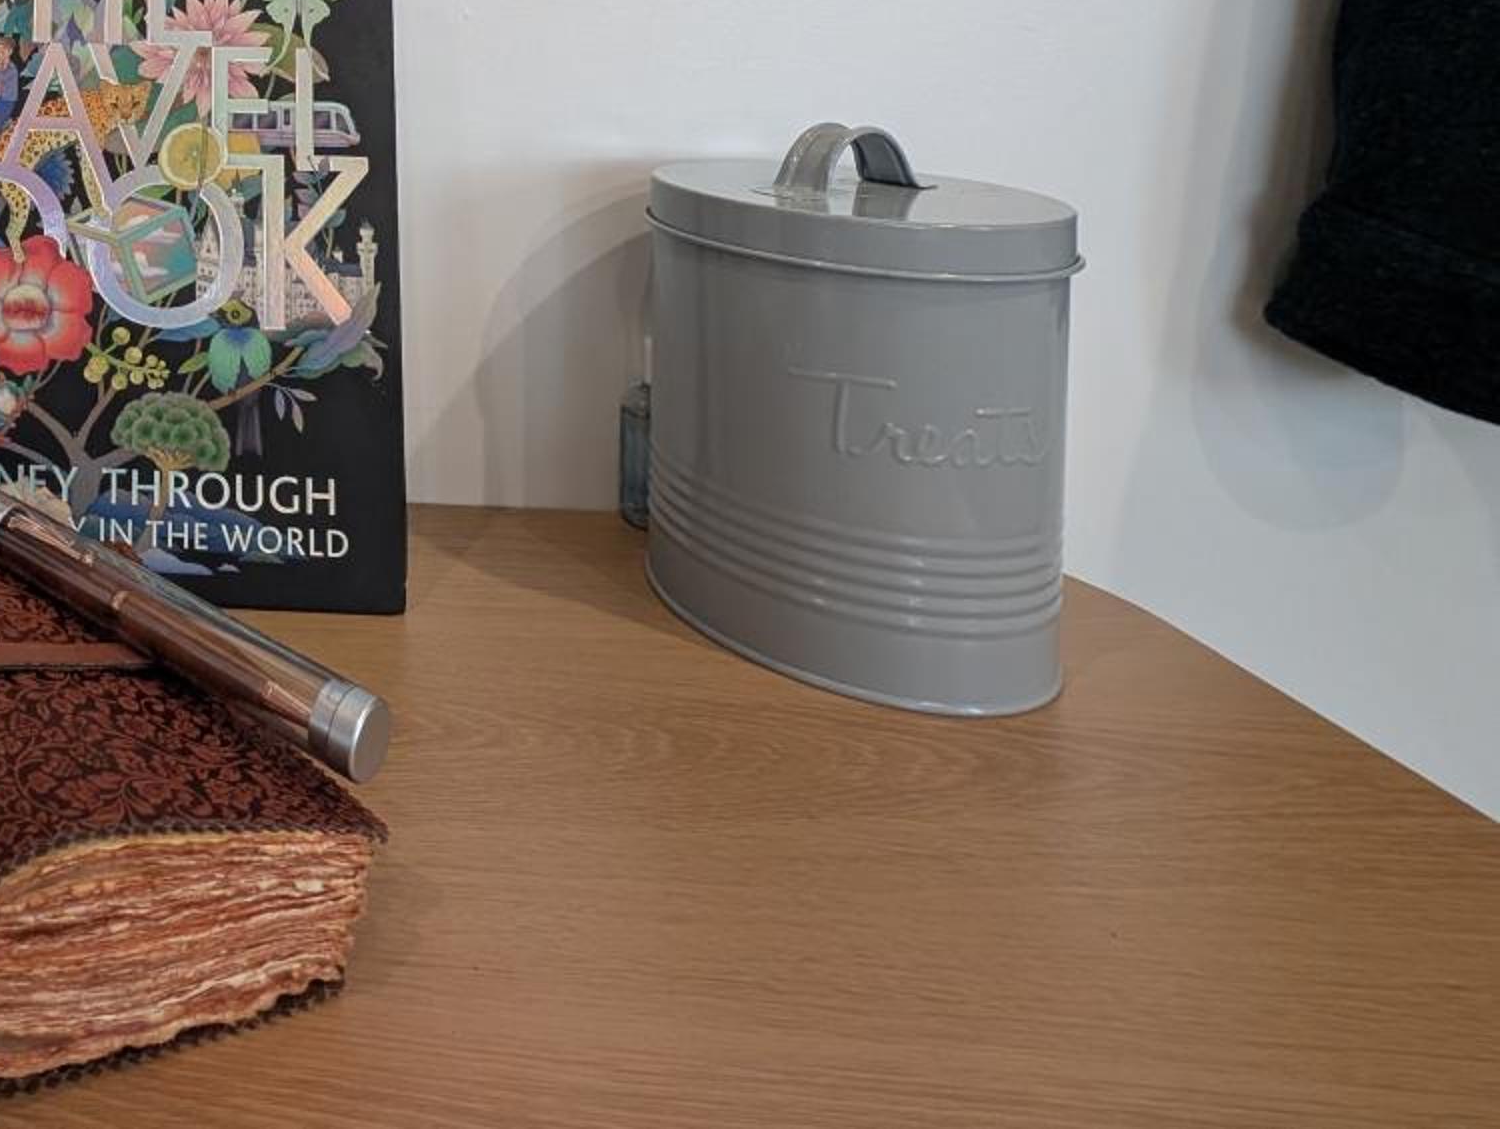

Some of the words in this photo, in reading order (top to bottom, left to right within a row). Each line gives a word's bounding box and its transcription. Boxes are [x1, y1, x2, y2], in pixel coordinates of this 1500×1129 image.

[101, 468, 337, 516] THROUGH
[99, 517, 134, 545] IN
[145, 520, 209, 550] THE
[221, 524, 349, 558] WORLD
